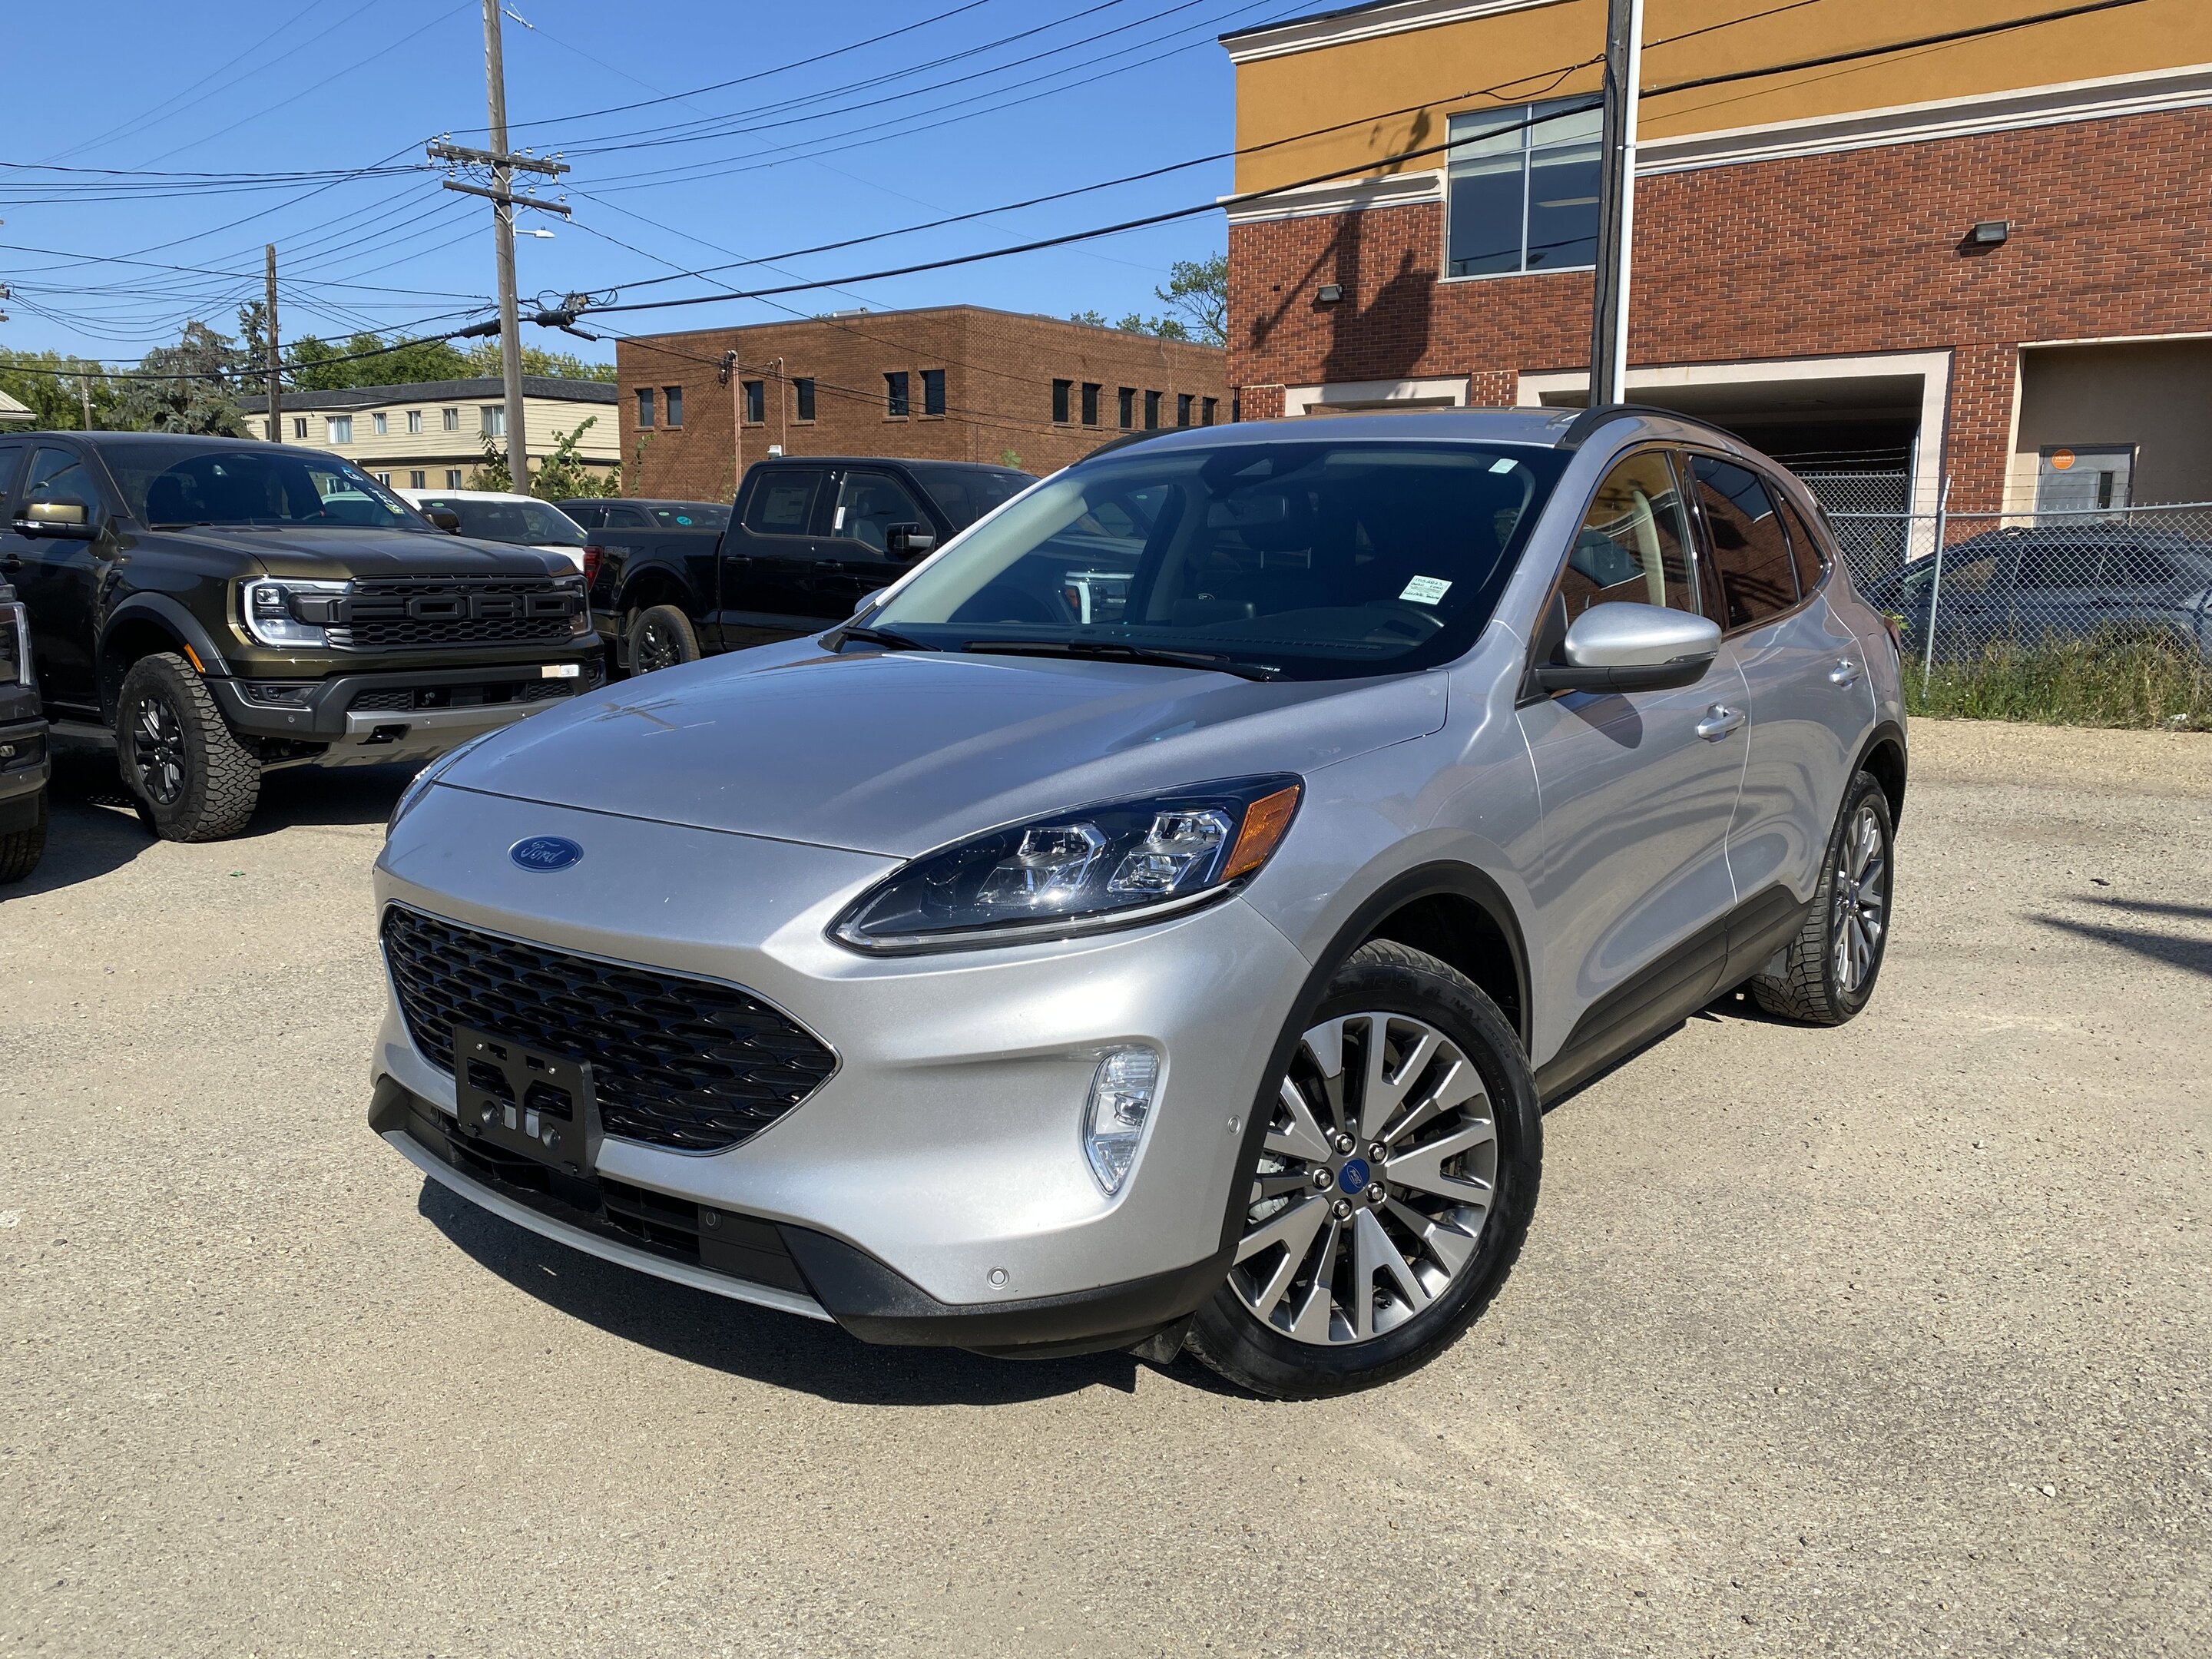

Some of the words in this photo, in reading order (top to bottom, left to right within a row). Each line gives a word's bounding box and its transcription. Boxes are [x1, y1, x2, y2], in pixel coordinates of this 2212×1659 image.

[604, 545, 631, 558] FX4
[337, 594, 574, 622] FORD
[520, 840, 565, 863] Ford
